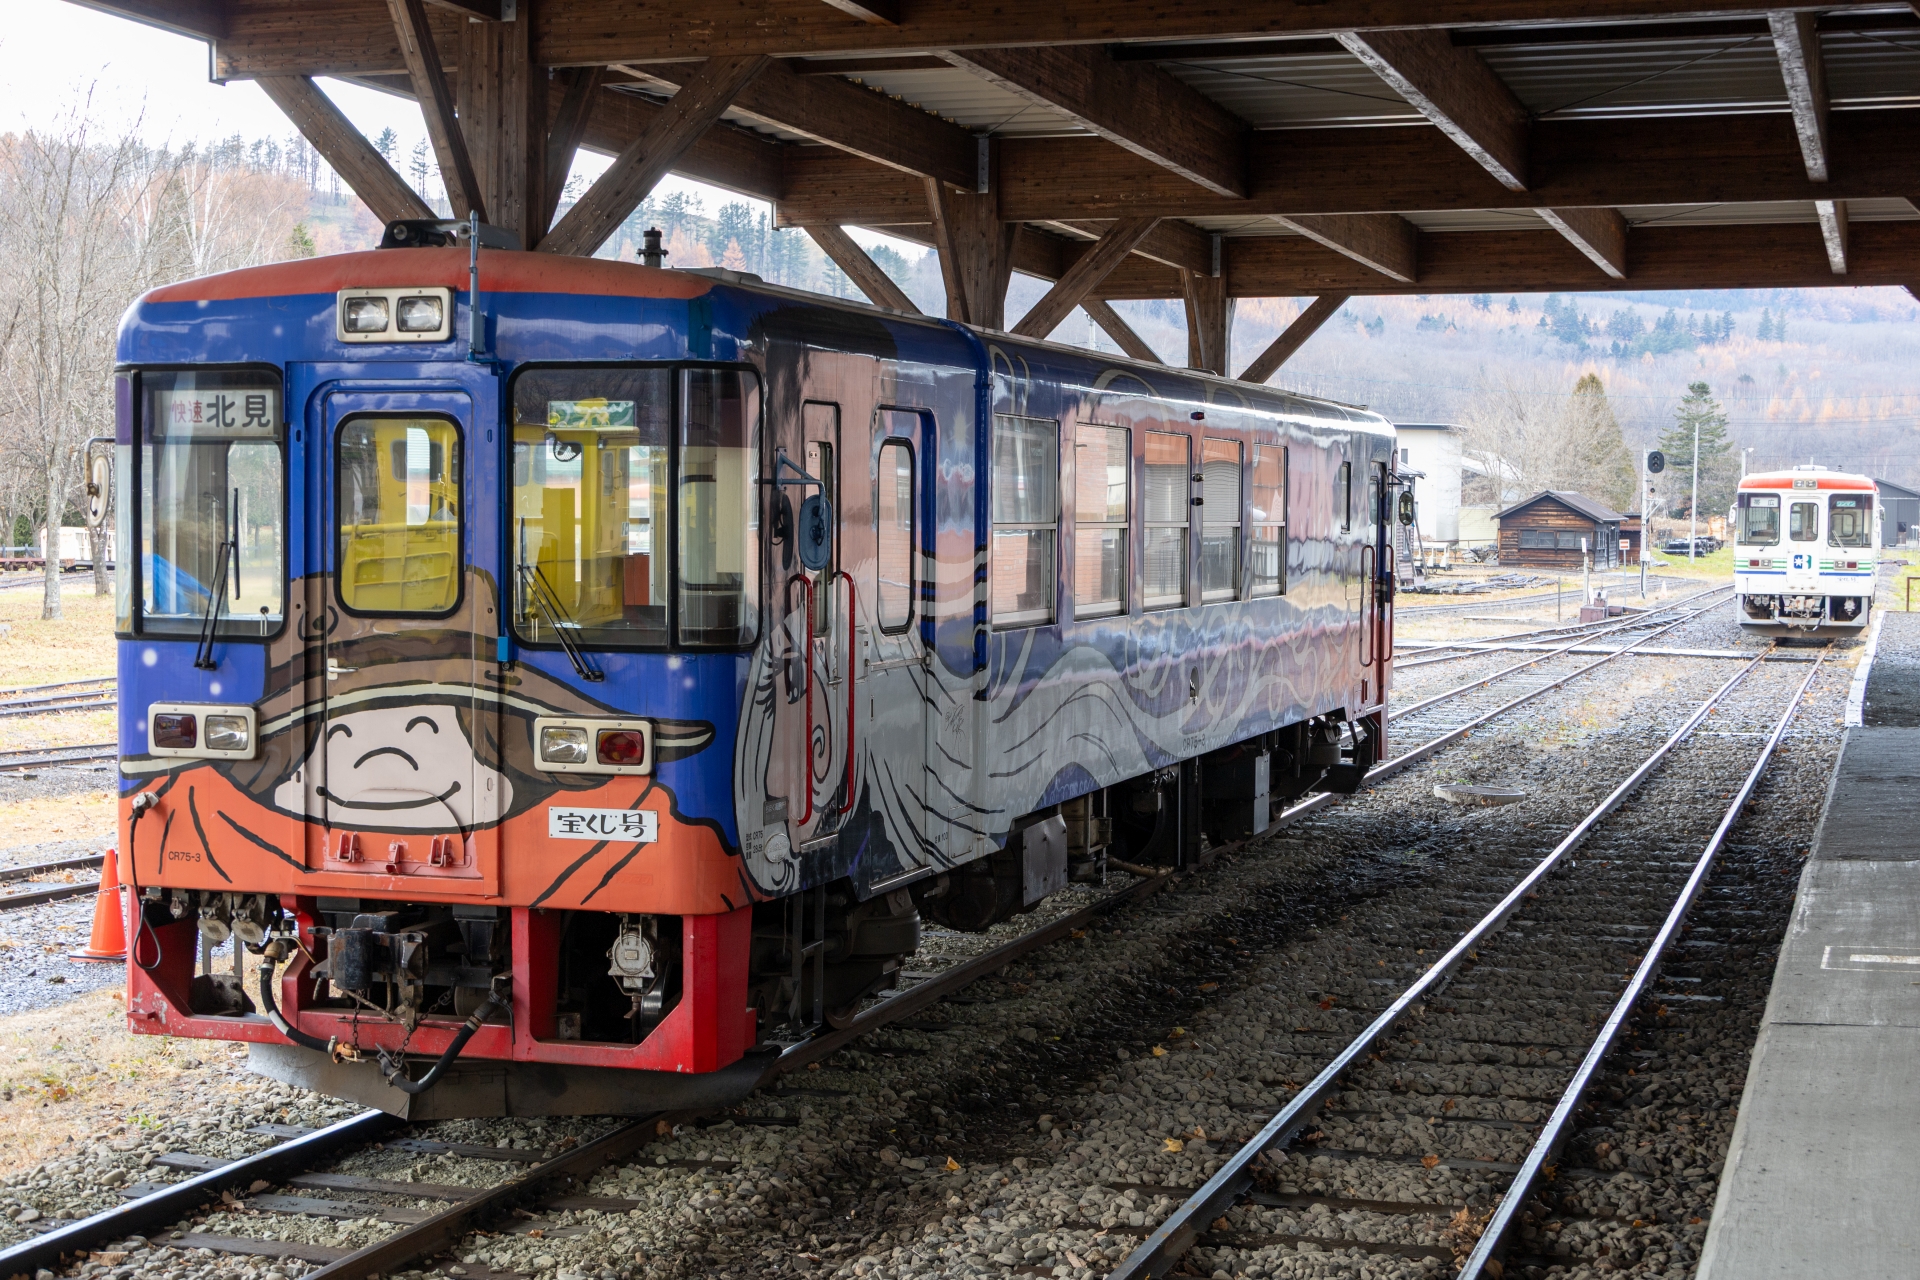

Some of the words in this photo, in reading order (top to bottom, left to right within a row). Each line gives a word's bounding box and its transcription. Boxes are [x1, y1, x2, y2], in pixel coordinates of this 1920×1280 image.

[171, 399, 203, 424] 快速
[206, 393, 272, 429] 北見
[556, 812, 647, 839] 宝くじ号
[167, 851, 202, 863] CR75-3
